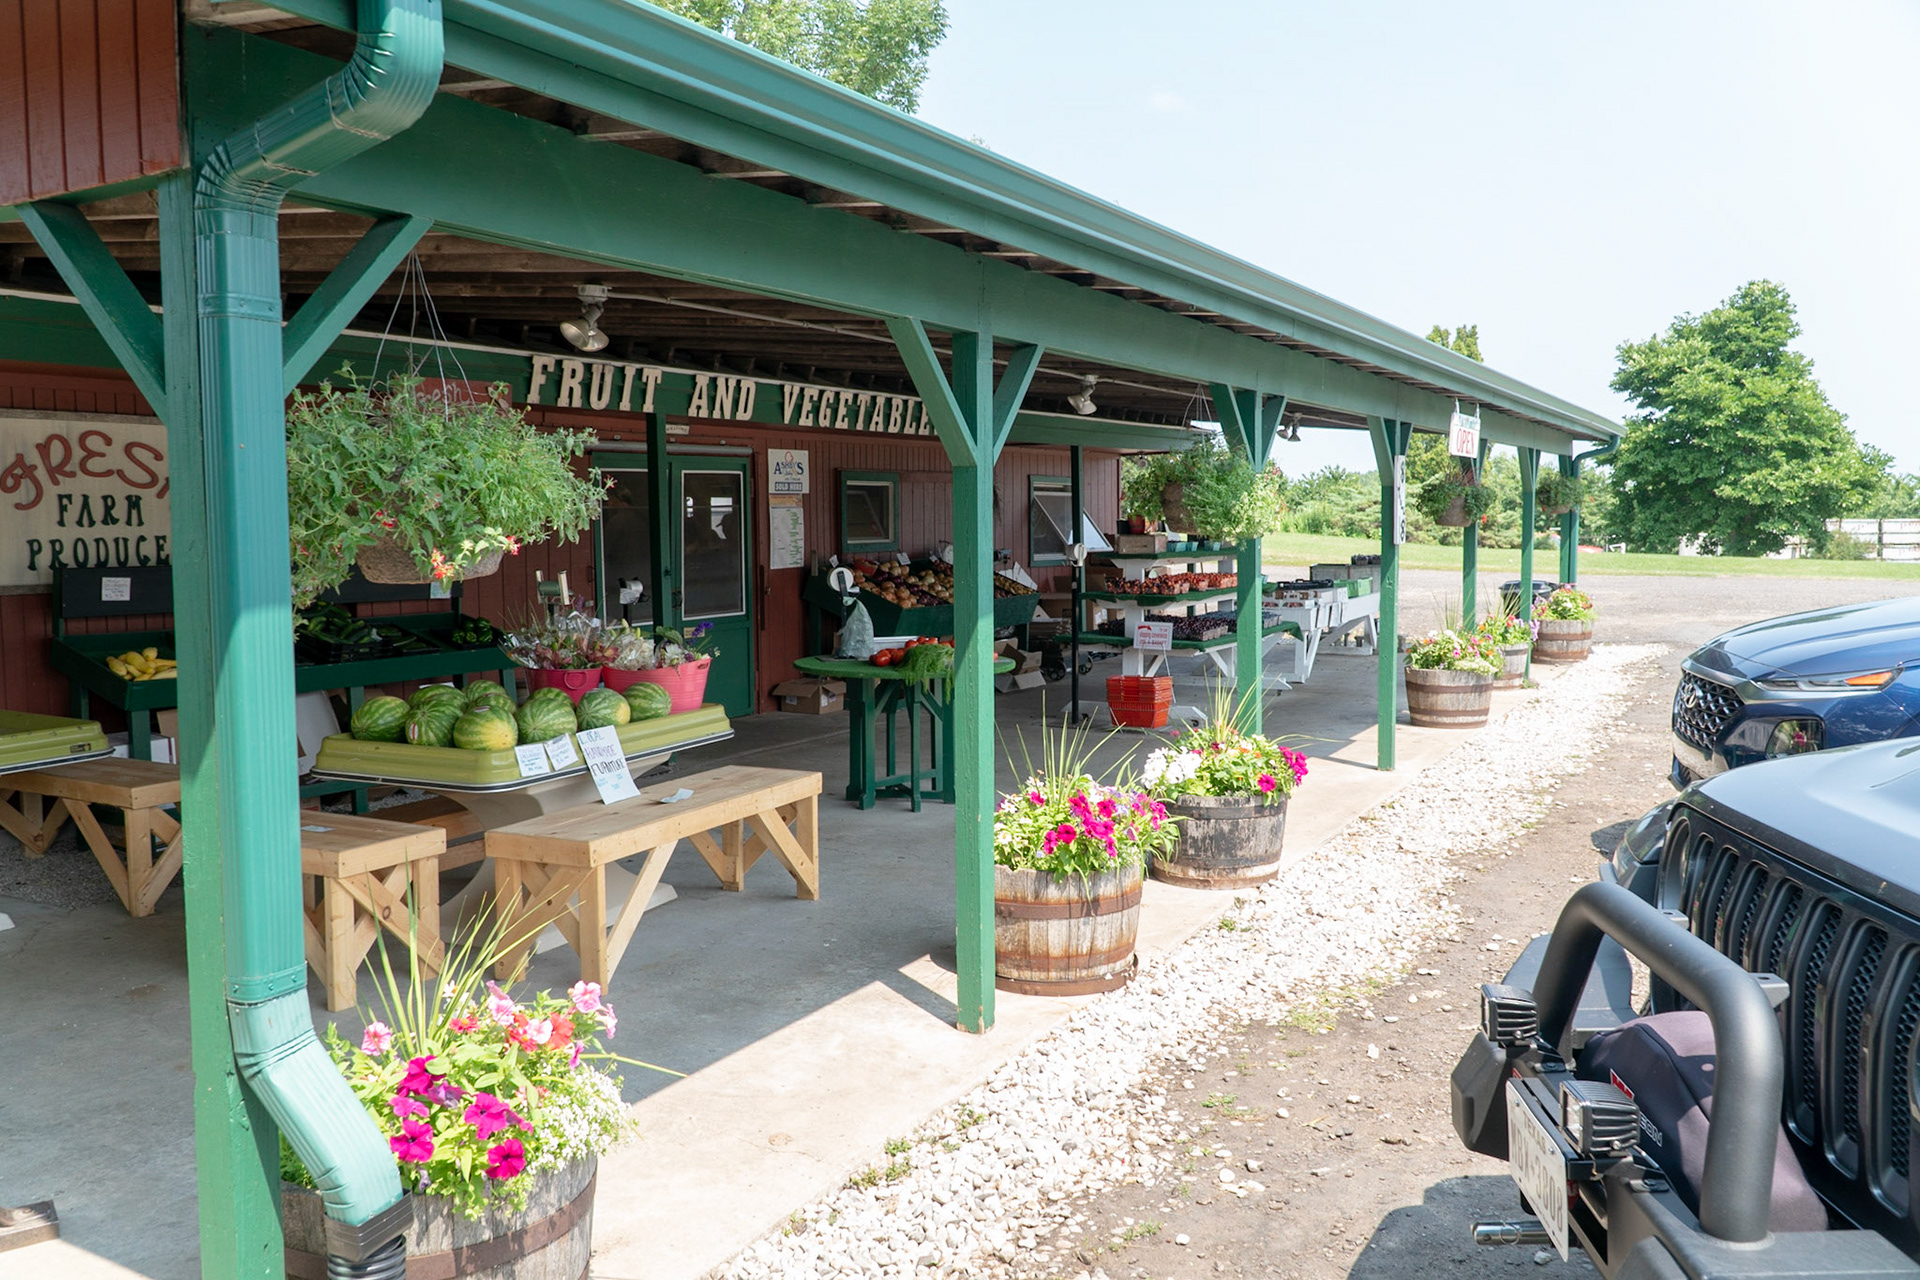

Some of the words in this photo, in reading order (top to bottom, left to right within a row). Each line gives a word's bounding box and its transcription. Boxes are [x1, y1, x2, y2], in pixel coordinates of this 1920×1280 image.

[526, 354, 663, 413] FRUIT
[687, 373, 757, 421] AND
[783, 384, 938, 436] VEGETABLE
[1456, 428, 1475, 455] OPEN
[0, 430, 170, 511] FRES
[57, 493, 144, 528] FARM
[26, 535, 170, 571] PRODUCE
[1523, 1110, 1547, 1156] TEXAS
